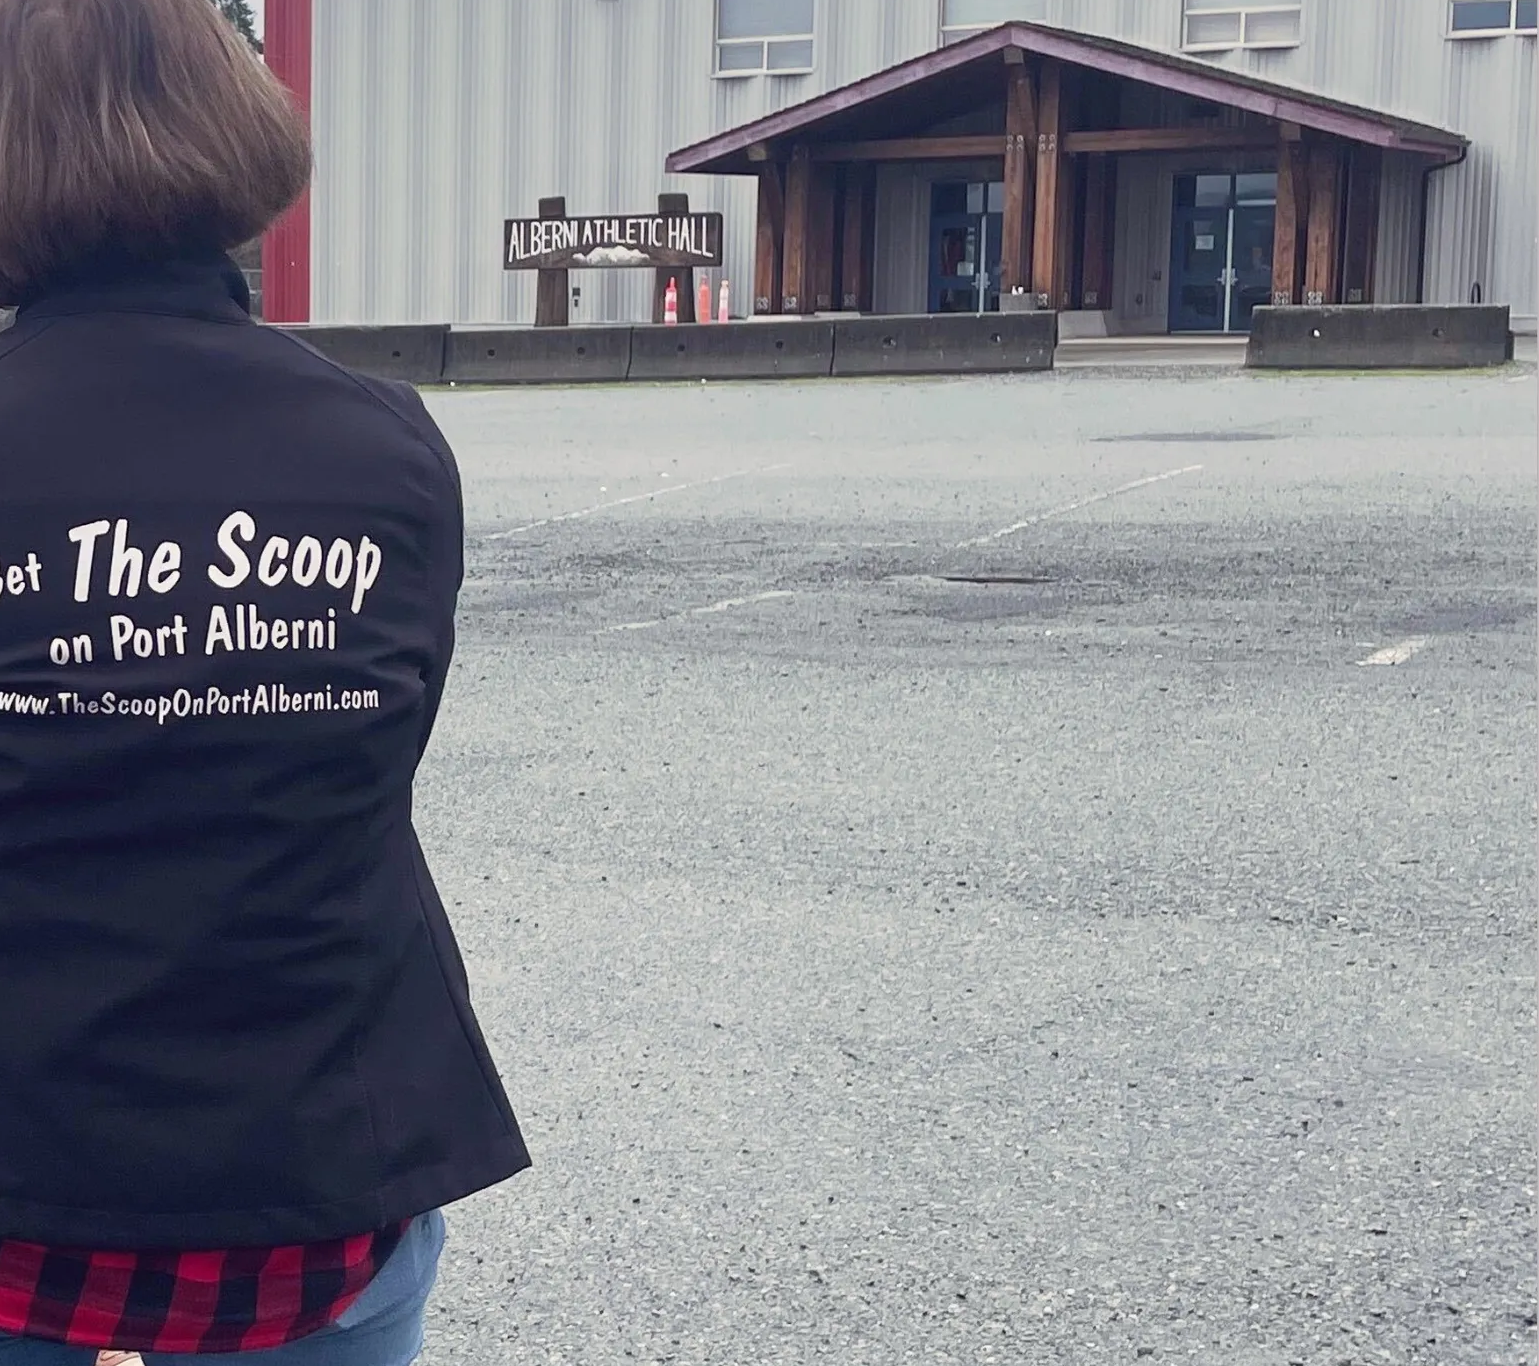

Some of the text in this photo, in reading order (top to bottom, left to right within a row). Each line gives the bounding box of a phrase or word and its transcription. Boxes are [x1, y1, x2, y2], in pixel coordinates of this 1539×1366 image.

[508, 216, 714, 262] ALBERNI ATHLETIC HALL
[68, 518, 181, 603] The
[207, 510, 381, 614] Scoop
[50, 603, 336, 665] on Port Alberni
